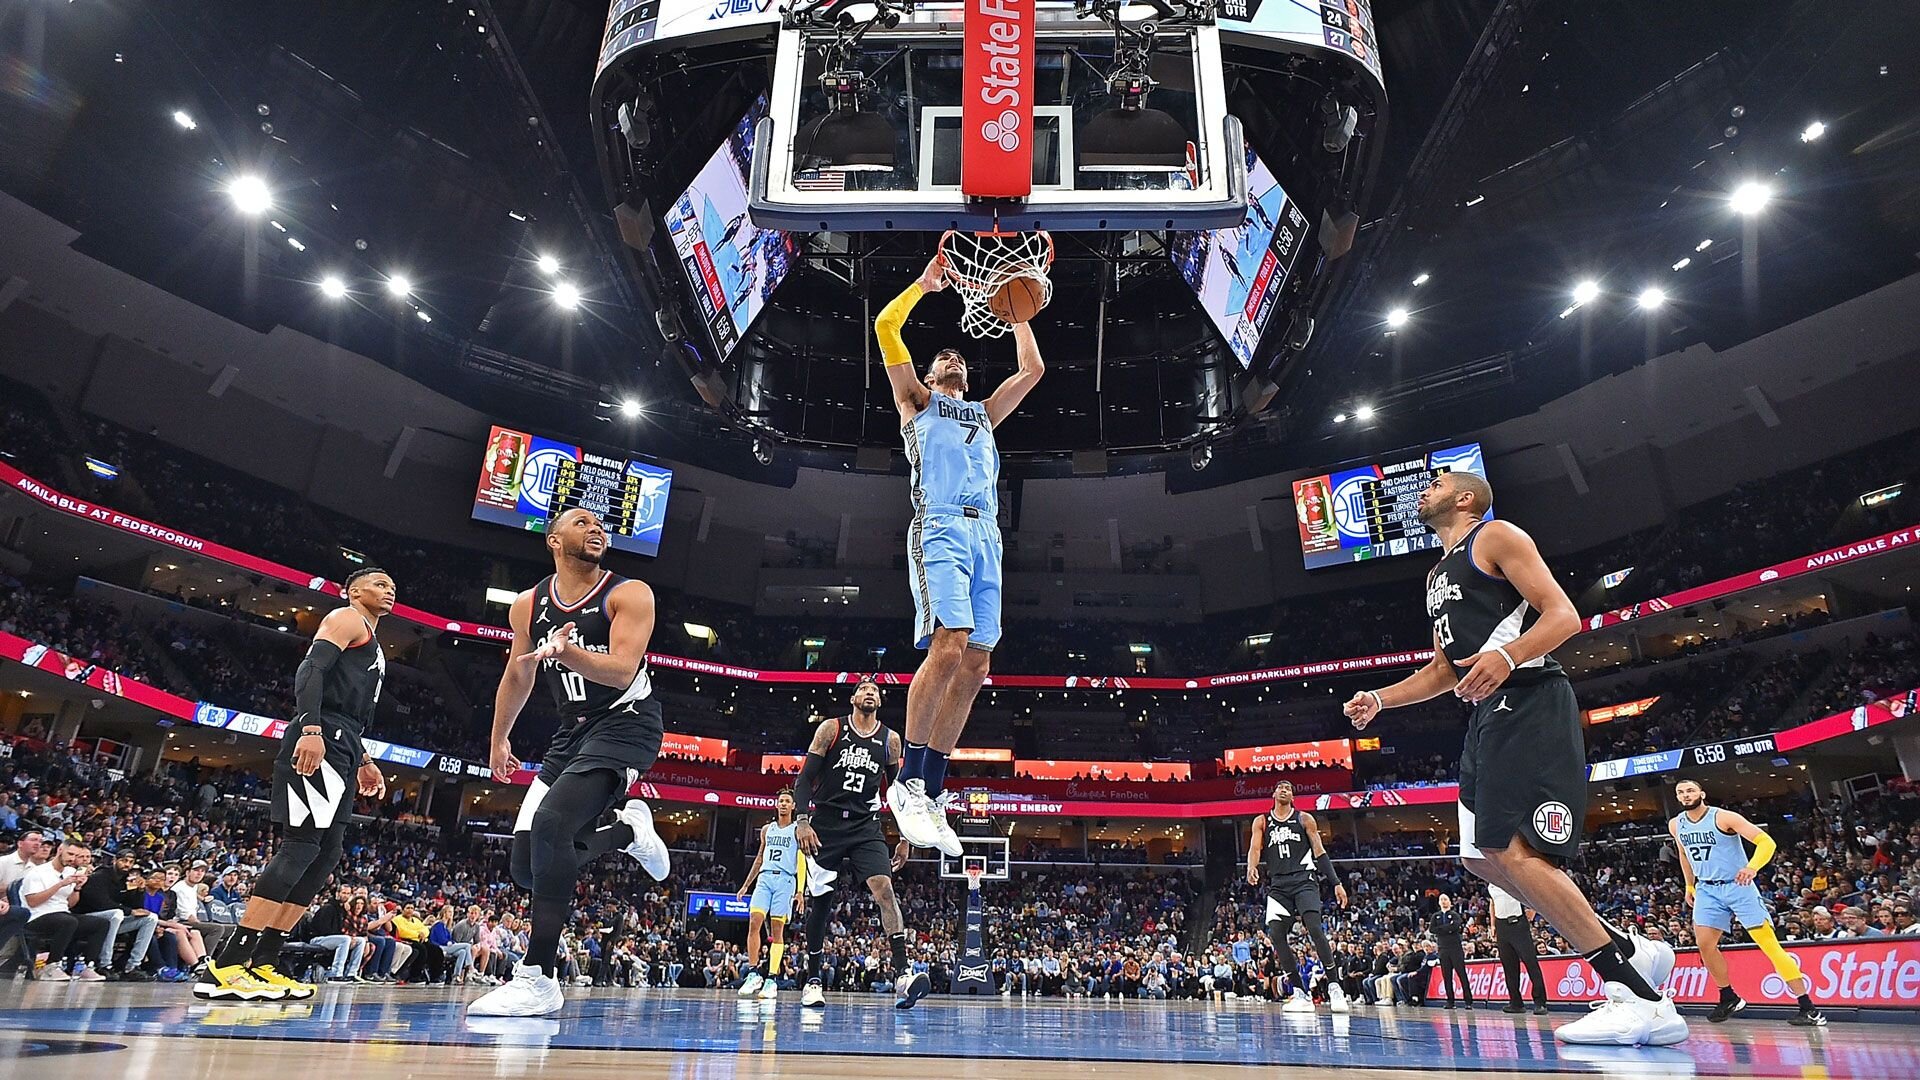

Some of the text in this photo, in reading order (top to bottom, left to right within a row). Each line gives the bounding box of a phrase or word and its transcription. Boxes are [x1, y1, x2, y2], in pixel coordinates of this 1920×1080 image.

[1226, 4, 1248, 18] QTR
[1326, 10, 1342, 26] 24
[1330, 31, 1344, 46] 27
[687, 221, 699, 244] 85
[677, 234, 690, 256] 78
[1276, 226, 1294, 256] 6:58
[715, 315, 731, 340] 6:58
[960, 422, 980, 444] 7
[584, 452, 603, 465] GAME
[580, 464, 594, 475] FIELD
[595, 468, 614, 479] GOALS
[1380, 470, 1432, 488] 2ND CHANCE PTS
[580, 473, 619, 489] FREE THROWS
[1384, 480, 1431, 496] FASTBREAK PTS
[1396, 491, 1422, 503] ASSISTS
[17, 478, 204, 551] AVAILABLE AT FEDEXFORUM
[579, 500, 610, 513] REBOUNDS
[1387, 514, 1398, 522] PTS
[1398, 512, 1407, 520] OFF
[1404, 526, 1426, 537] DUNKS
[1373, 544, 1385, 556] 77
[1410, 536, 1425, 550] 74
[1806, 532, 1910, 568] AVAILABLE AT
[477, 626, 514, 640] CINTRO
[651, 656, 684, 668] BRINGS
[686, 661, 724, 674] MEMPHIS
[726, 668, 759, 680] ENERGY
[1210, 674, 1249, 686] CINTRON
[1251, 668, 1301, 681] SPARKLING
[1303, 662, 1340, 674] ENERGY
[1342, 658, 1373, 670] DRINK
[1375, 654, 1412, 665] BRINGS
[560, 672, 586, 702] 10
[241, 715, 259, 733] 85
[365, 740, 378, 756] 78
[683, 744, 700, 752] with
[850, 744, 869, 757] Los
[1276, 752, 1300, 762] points
[1302, 750, 1320, 758] with
[1694, 740, 1774, 765] 6:58 3RD QTR
[439, 756, 492, 777] 6:58 3RD QTR
[833, 751, 880, 774] Angeles
[1602, 762, 1618, 777] 78
[670, 773, 710, 786] FanDeck
[842, 772, 866, 794] 23
[1110, 790, 1150, 800] FanDeck
[1020, 804, 1062, 812] ENERGY
[767, 836, 792, 848] GRIZZLIES
[1680, 831, 1716, 846] GRIZZLIES
[770, 850, 782, 862] 12
[1278, 844, 1290, 859] 14
[1690, 846, 1712, 862] 27
[1815, 950, 1920, 1000] State
